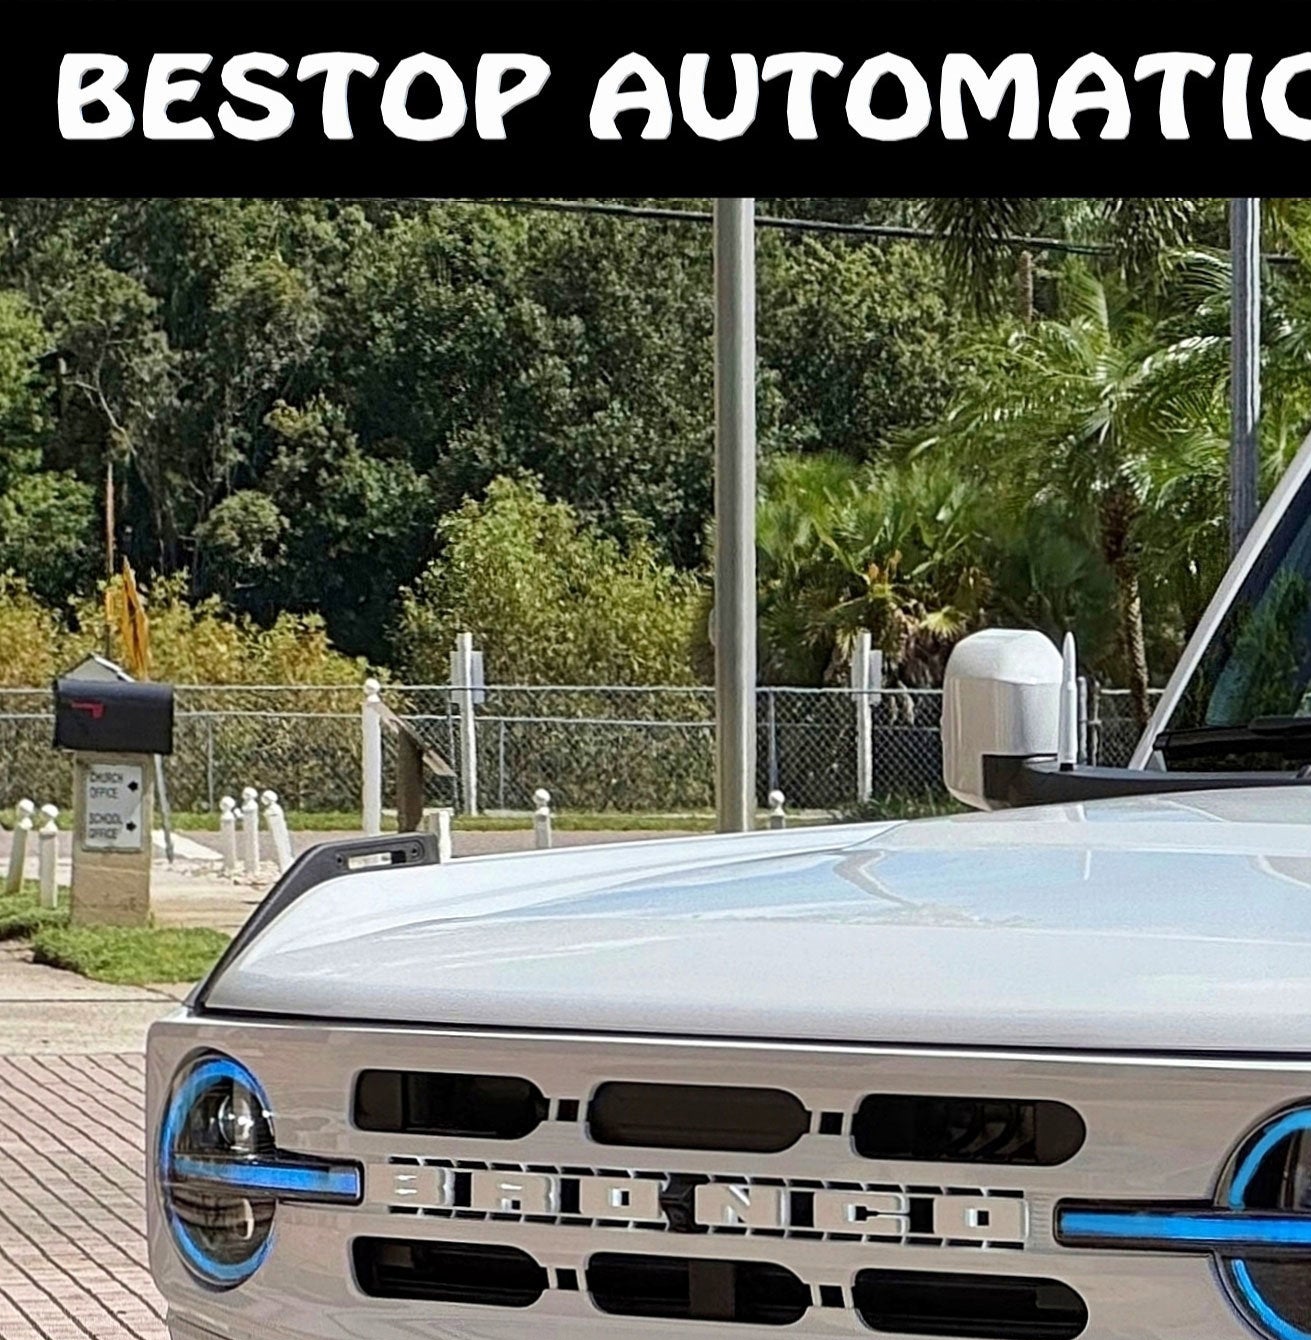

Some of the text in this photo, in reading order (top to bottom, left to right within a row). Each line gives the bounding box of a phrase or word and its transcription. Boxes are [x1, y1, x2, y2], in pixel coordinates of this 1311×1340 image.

[90, 771, 123, 784] CHURCH
[89, 786, 119, 799] OFFICE
[89, 812, 123, 825] SCHOOL
[89, 827, 118, 840] OFFICE
[363, 1162, 1029, 1242] BRONCO
